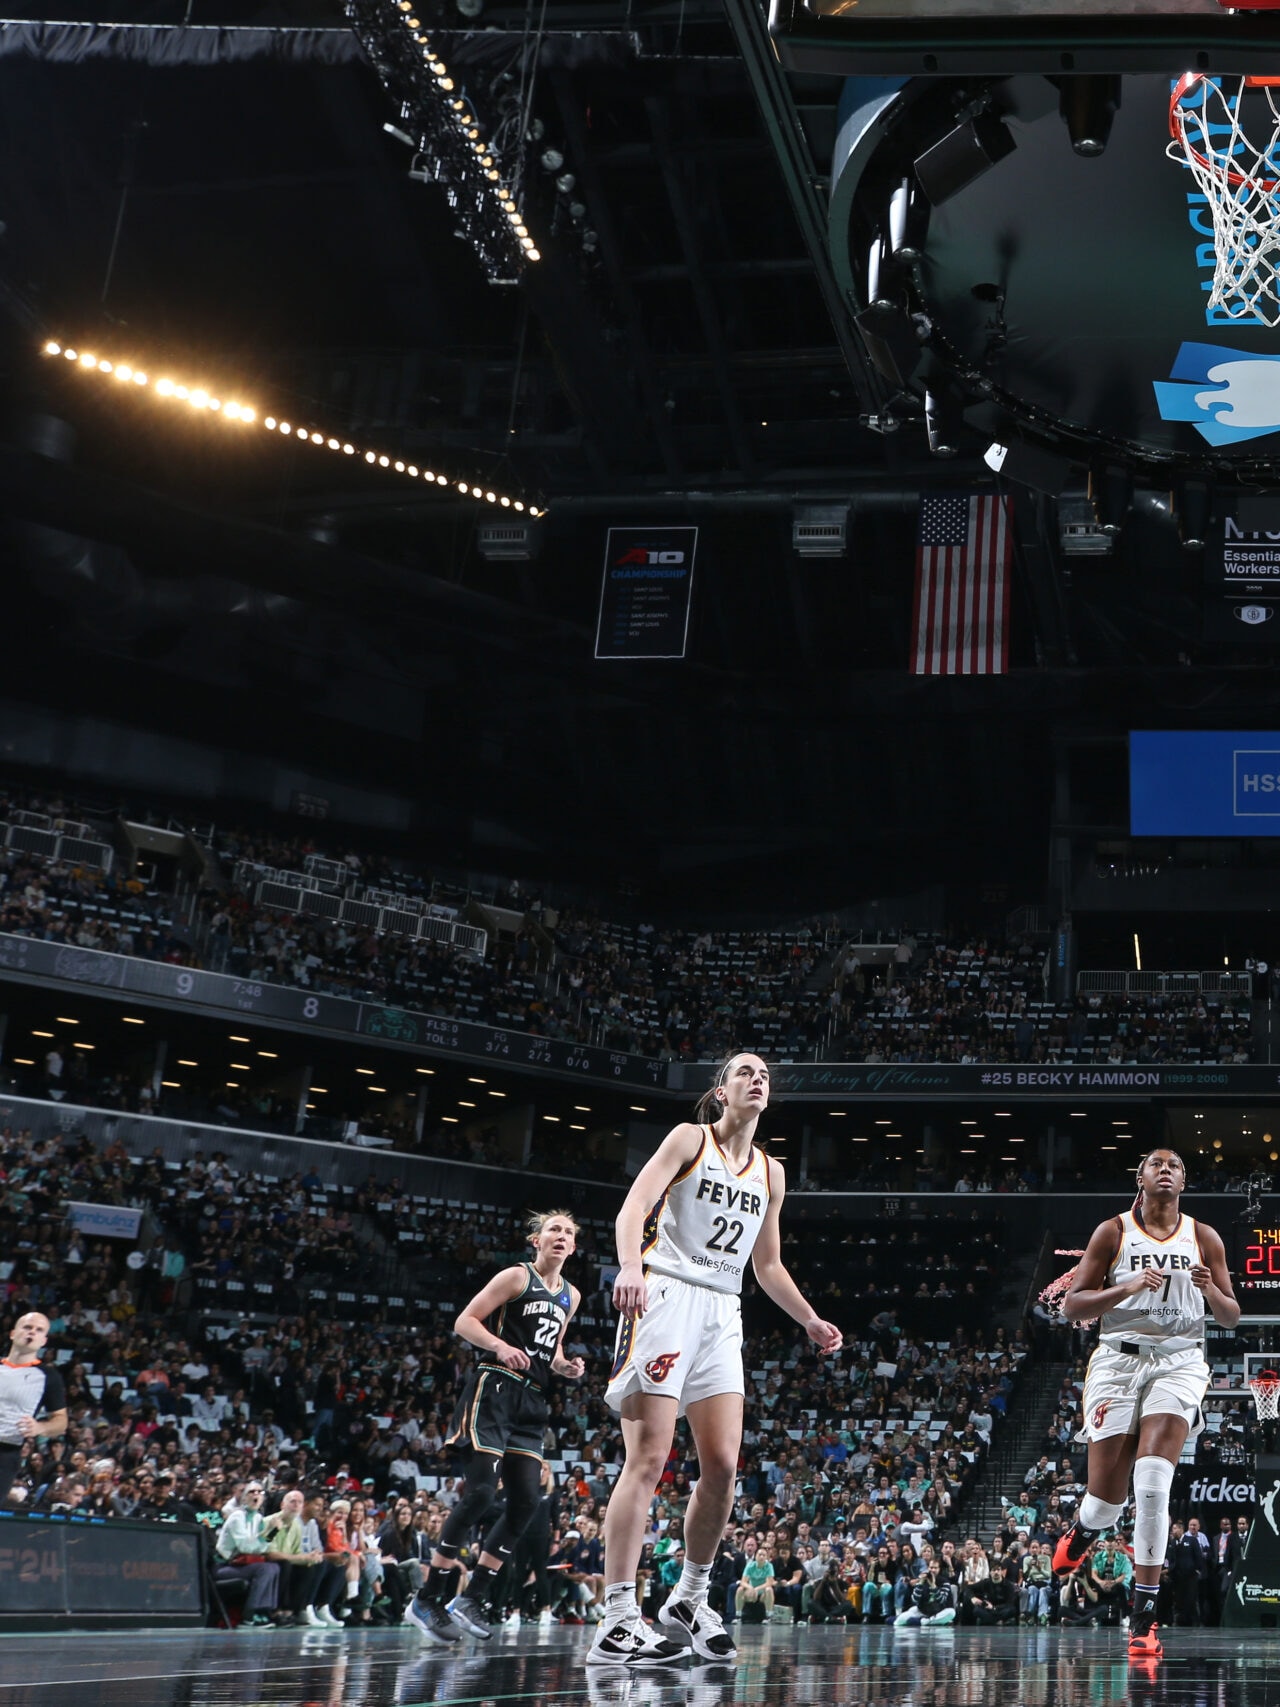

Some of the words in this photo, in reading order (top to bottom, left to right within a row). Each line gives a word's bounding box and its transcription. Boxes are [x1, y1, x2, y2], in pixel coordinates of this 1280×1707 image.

[610, 569, 687, 579] CHAMPIONSHIP
[1224, 563, 1280, 574] Workers
[176, 973, 194, 995] 9
[232, 981, 262, 998] 7:48
[303, 997, 319, 1019] 8
[426, 1032, 449, 1045] TOL:
[450, 1036, 458, 1046] 5
[493, 1032, 507, 1043] FG
[609, 1054, 628, 1065] REB
[646, 1062, 665, 1073] AST
[614, 1065, 621, 1076] 0
[981, 1072, 1012, 1085] #25
[1017, 1072, 1075, 1085] BECKY
[1078, 1072, 1160, 1085] HAMMON
[1163, 1073, 1229, 1086] (1999-2006)
[696, 1178, 762, 1217] FEVER
[705, 1215, 744, 1255] 22
[690, 1254, 741, 1276] salesforce
[1130, 1254, 1191, 1271] FEVER
[1162, 1274, 1172, 1303] 7
[522, 1300, 548, 1316] NEW
[1140, 1307, 1183, 1318] salesforce
[534, 1317, 560, 1348] 22
